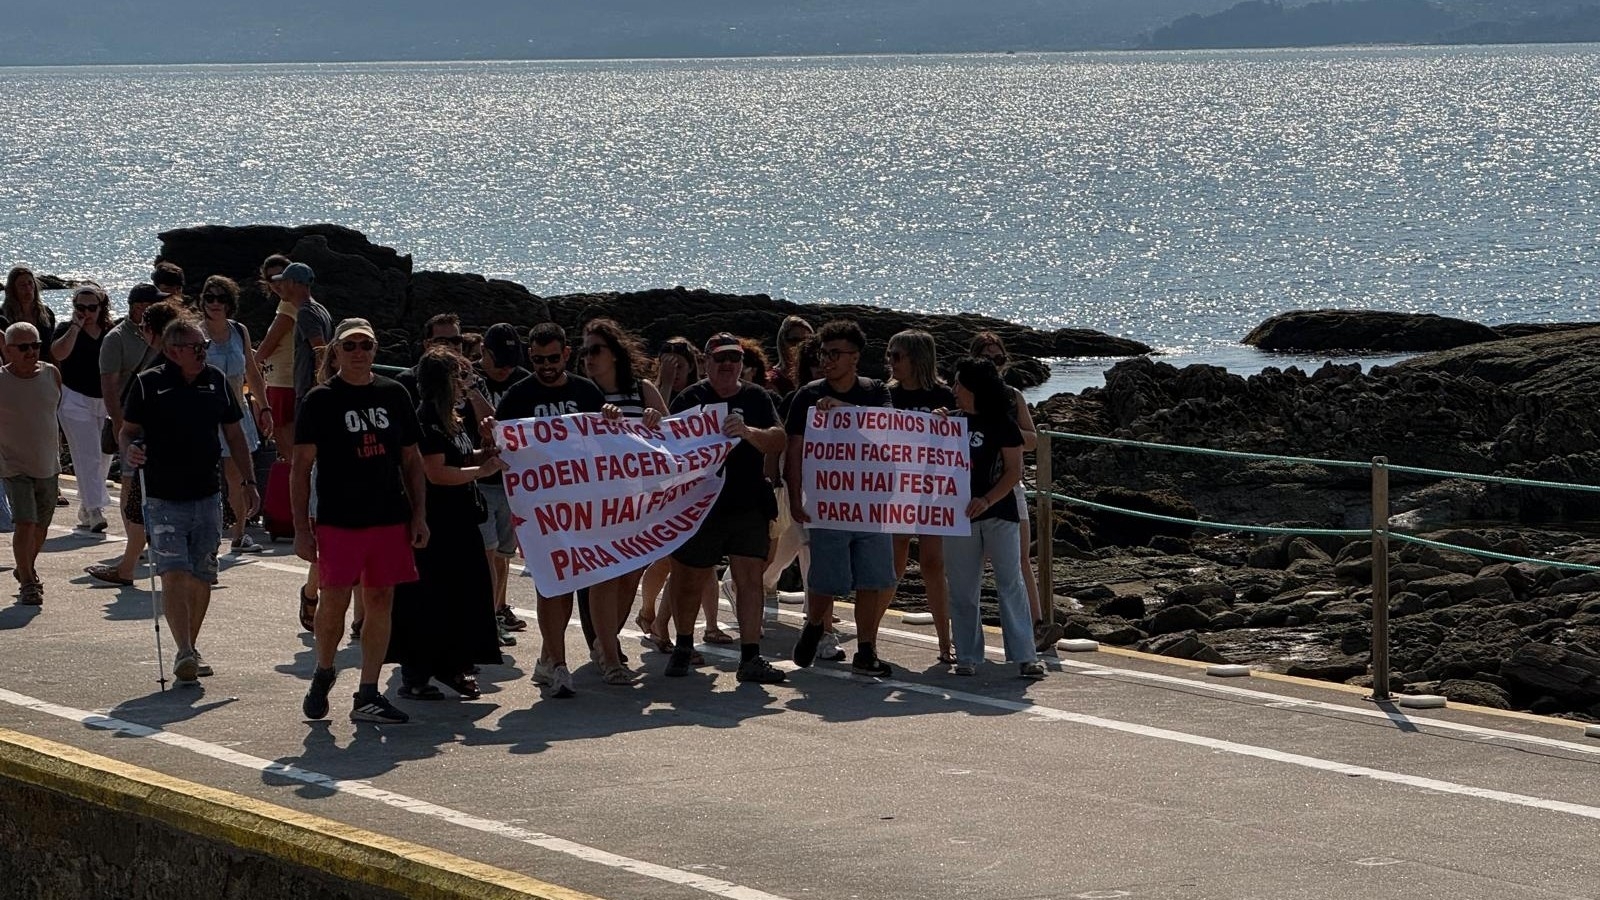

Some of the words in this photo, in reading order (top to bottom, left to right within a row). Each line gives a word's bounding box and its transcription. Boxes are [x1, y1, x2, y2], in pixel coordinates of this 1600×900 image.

[344, 407, 390, 433] ONS
[503, 424, 528, 451] SI
[533, 417, 568, 443] OS
[669, 409, 721, 440] NON
[812, 410, 829, 429] SI
[833, 412, 851, 430] OS
[929, 418, 962, 437] NON
[803, 441, 856, 461] PODEN
[861, 444, 912, 463] FACER
[917, 446, 969, 471] FESTA,
[505, 458, 590, 497] PODEN
[594, 451, 671, 481] FACER
[816, 470, 854, 491] NON
[861, 472, 893, 492] HAI
[900, 474, 957, 496] FESTA
[534, 501, 592, 536] NON
[601, 494, 644, 527] HAI
[817, 501, 863, 523] PARA
[869, 504, 955, 527] NINGUEN
[550, 544, 620, 581] PARA
